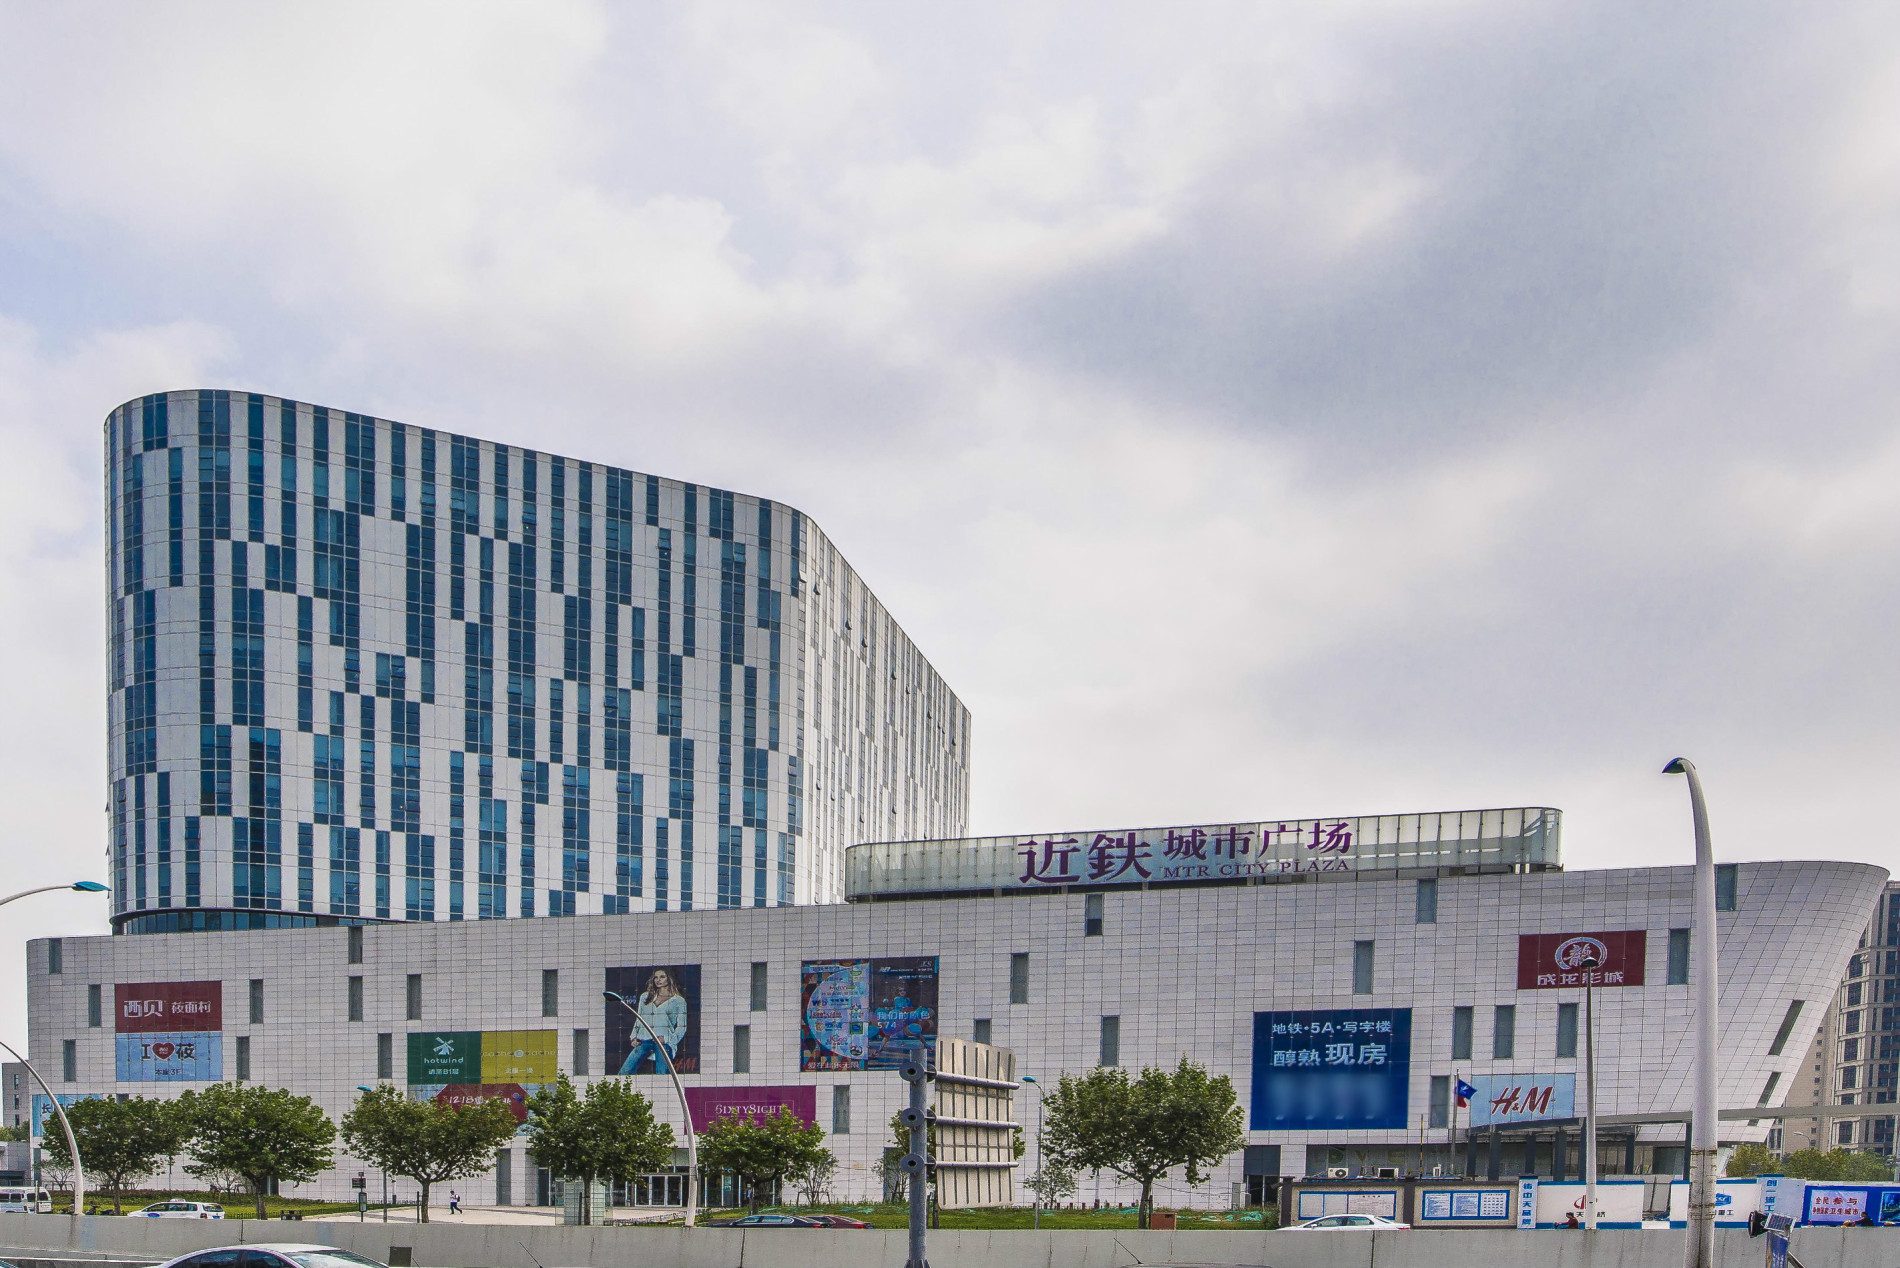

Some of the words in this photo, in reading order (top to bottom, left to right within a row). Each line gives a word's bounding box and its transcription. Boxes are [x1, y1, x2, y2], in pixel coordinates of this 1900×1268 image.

[1163, 864, 1209, 878] MTR
[1220, 862, 1270, 875] CITY
[1280, 859, 1350, 873] PLAZA
[1537, 971, 1624, 986] 成龙影城
[123, 1000, 163, 1017] 西贝
[1272, 1020, 1392, 1034] 地铁·5A·写字楼
[423, 1056, 464, 1064] hotwind
[1491, 1086, 1554, 1115] H&M
